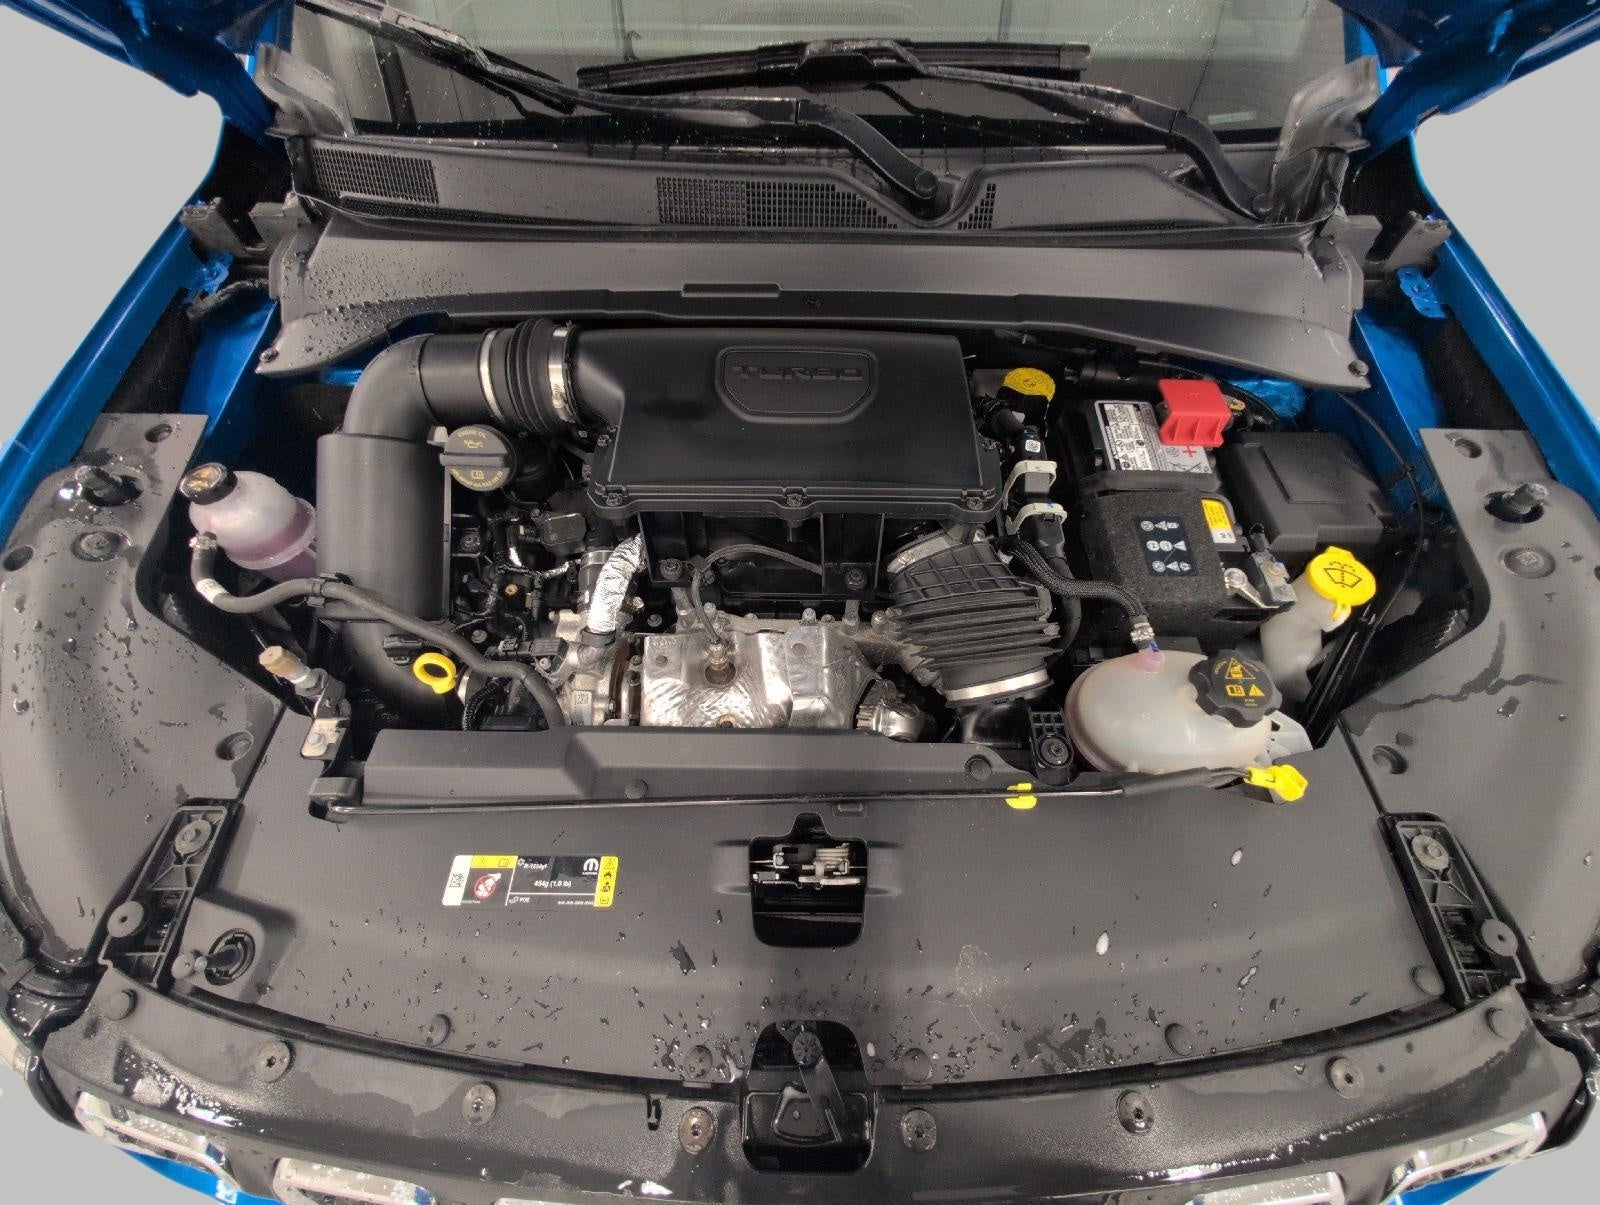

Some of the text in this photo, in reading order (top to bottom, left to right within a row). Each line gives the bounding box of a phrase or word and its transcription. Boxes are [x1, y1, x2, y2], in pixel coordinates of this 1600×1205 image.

[732, 365, 864, 381] TURBO
[457, 429, 477, 437] ENGINE
[534, 880, 549, 888] 454g
